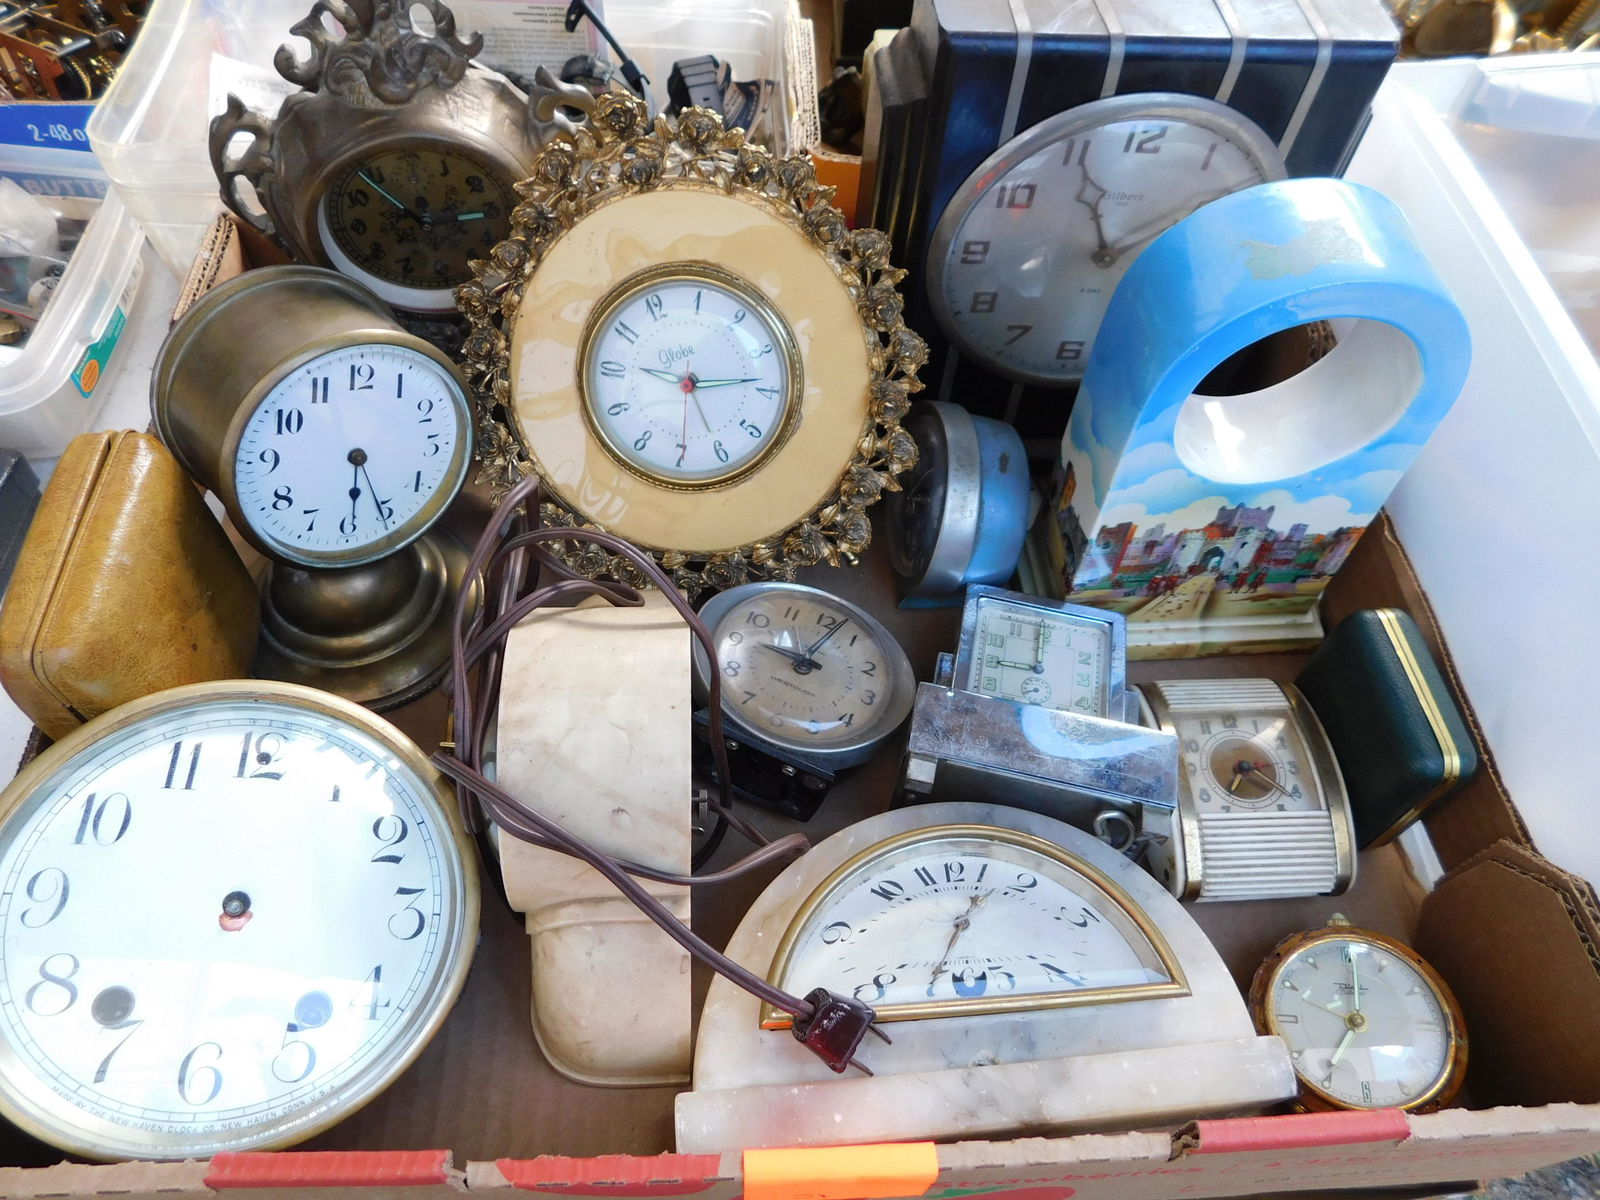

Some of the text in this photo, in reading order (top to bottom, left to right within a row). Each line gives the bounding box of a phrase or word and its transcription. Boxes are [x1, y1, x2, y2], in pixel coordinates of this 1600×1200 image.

[26, 123, 88, 141] 2-48 o
[1123, 125, 1168, 154] 12
[1062, 139, 1091, 167] 11
[1201, 143, 1217, 171] 1
[22, 179, 105, 196] BUTTE
[996, 183, 1037, 210] 10
[960, 240, 991, 265] 9
[645, 294, 668, 322] 12
[692, 290, 702, 315] 1
[970, 291, 999, 314] 8
[614, 320, 640, 345] 11
[1004, 325, 1033, 346] 7
[658, 343, 696, 369] Globe
[1056, 340, 1085, 361] 6
[350, 363, 375, 391] 12
[600, 360, 626, 379] 10
[311, 376, 329, 404] 11
[397, 373, 403, 398] 1
[755, 385, 780, 400] 4
[275, 407, 304, 435] 10
[417, 398, 434, 424] 2
[607, 402, 631, 417] 9
[633, 430, 652, 451] 8
[739, 418, 763, 439] 5
[423, 433, 440, 457] 3
[674, 442, 688, 468] 7
[713, 439, 730, 464] 6
[259, 448, 280, 476] 9
[272, 485, 293, 510] 8
[303, 508, 319, 531] 7
[375, 498, 394, 522] 5
[339, 513, 357, 535] 6
[746, 611, 770, 629] 10
[783, 606, 801, 621] 11
[816, 613, 837, 630] 12
[728, 631, 744, 646] 9
[849, 634, 858, 647] 1
[724, 661, 741, 678] 8
[861, 661, 877, 677] 2
[1078, 651, 1092, 666] 2
[741, 690, 757, 705] 7
[860, 689, 876, 706] 3
[1075, 696, 1091, 711] 4
[838, 713, 855, 728] 4
[161, 740, 203, 790] 11
[232, 730, 290, 781] 12
[70, 791, 132, 847] 10
[371, 813, 409, 865] 2
[913, 865, 937, 887] 11
[943, 861, 965, 883] 12
[975, 863, 989, 883] 1
[1012, 872, 1038, 895] 2
[20, 867, 71, 929] 9
[870, 880, 905, 902] 10
[388, 885, 426, 941] 3
[1059, 905, 1101, 929] 3
[820, 920, 853, 946] 9
[24, 952, 81, 1017] 8
[1040, 962, 1088, 987] 4
[349, 963, 392, 1021] 4
[852, 972, 898, 1003] 8
[93, 1018, 145, 1085] 7
[271, 1021, 318, 1084] 5
[177, 1041, 224, 1106] 6
[1360, 1080, 1373, 1104] 6
[110, 1114, 130, 1127] NEW
[133, 1122, 162, 1133] HAVEN
[167, 1125, 199, 1136] CLOCK
[222, 1121, 242, 1130] NEW
